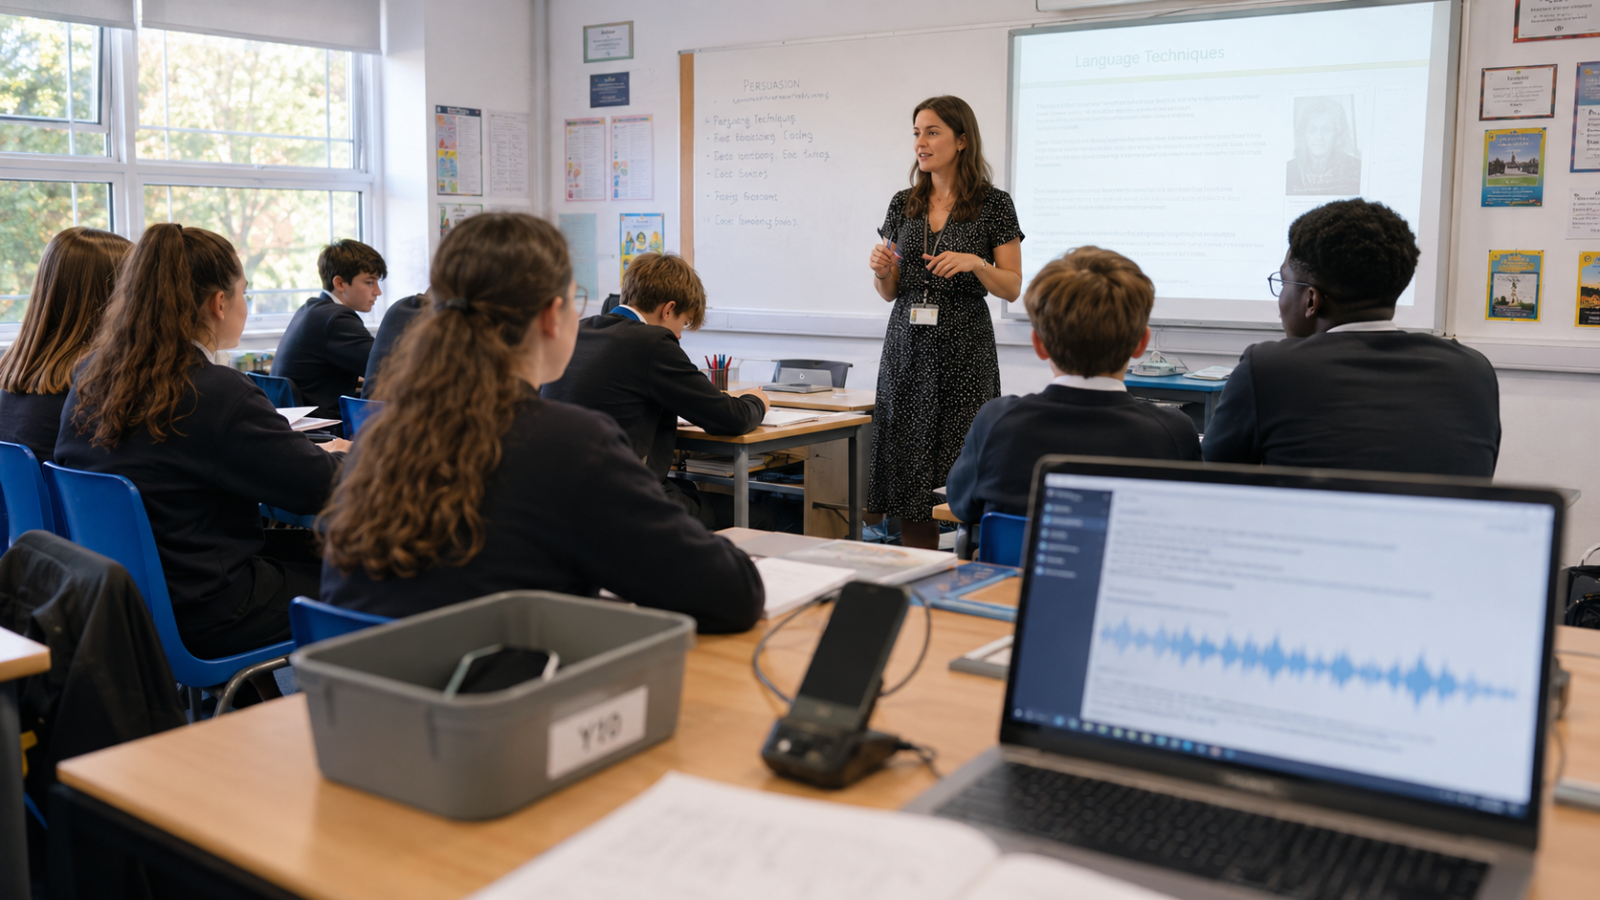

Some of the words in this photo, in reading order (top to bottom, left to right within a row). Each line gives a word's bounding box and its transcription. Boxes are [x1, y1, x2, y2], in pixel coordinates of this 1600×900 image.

[1075, 54, 1140, 70] Language
[1144, 47, 1225, 63] Techniques
[743, 78, 800, 92] PERSUASION
